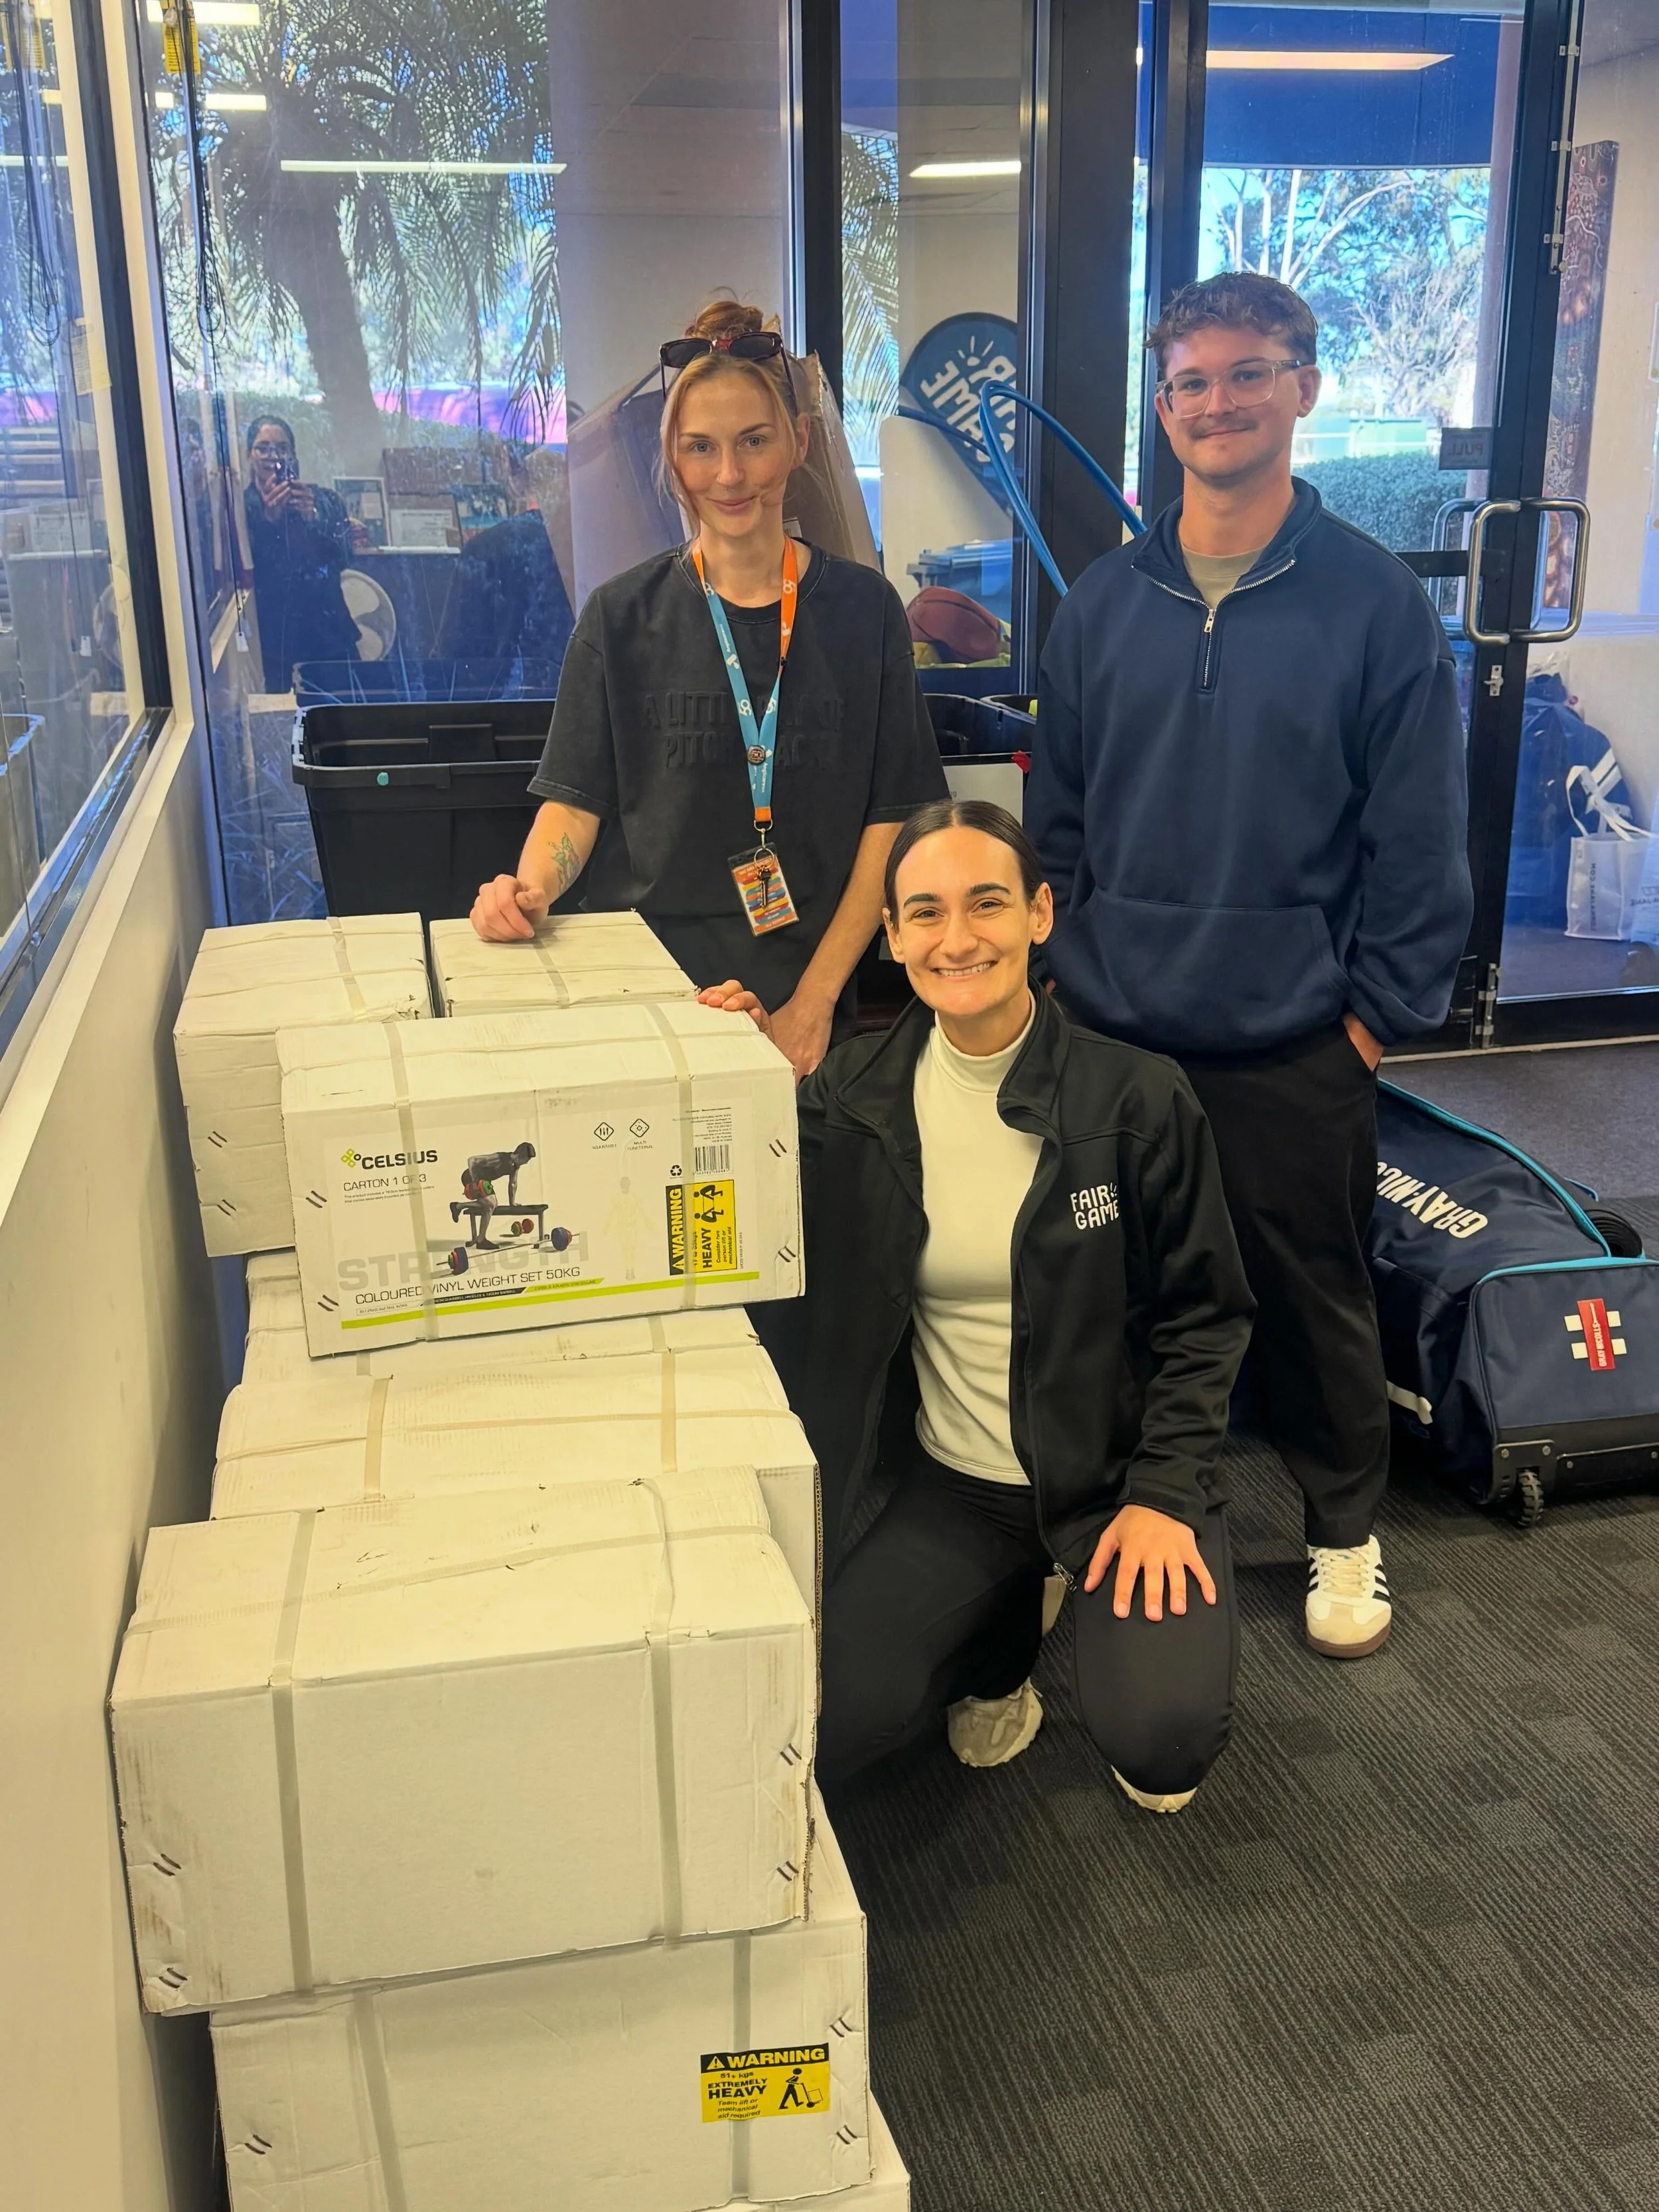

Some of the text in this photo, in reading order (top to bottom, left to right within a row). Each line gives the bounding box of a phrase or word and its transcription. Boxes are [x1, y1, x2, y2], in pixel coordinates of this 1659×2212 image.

[343, 1178, 389, 1191] CARTON
[392, 1177, 398, 1185] 1
[402, 1175, 417, 1185] OF
[419, 1173, 427, 1183] 3
[1070, 1185, 1111, 1213] FAIR
[669, 1188, 684, 1258] WARNING
[1075, 1199, 1119, 1230] GAME
[701, 1227, 712, 1268] HEAVY
[355, 1286, 423, 1305] COLOURED
[429, 1281, 464, 1295] VINYL
[467, 1274, 517, 1290] WEIGHT
[520, 1271, 543, 1283] SET
[546, 1267, 581, 1280] 50KG
[727, 2048, 825, 2069] WARNING
[707, 2078, 768, 2089] EXTREMELY
[708, 2085, 767, 2100] HEAVY
[717, 2104, 758, 2112] mechanical
[731, 2109, 760, 2120] required
